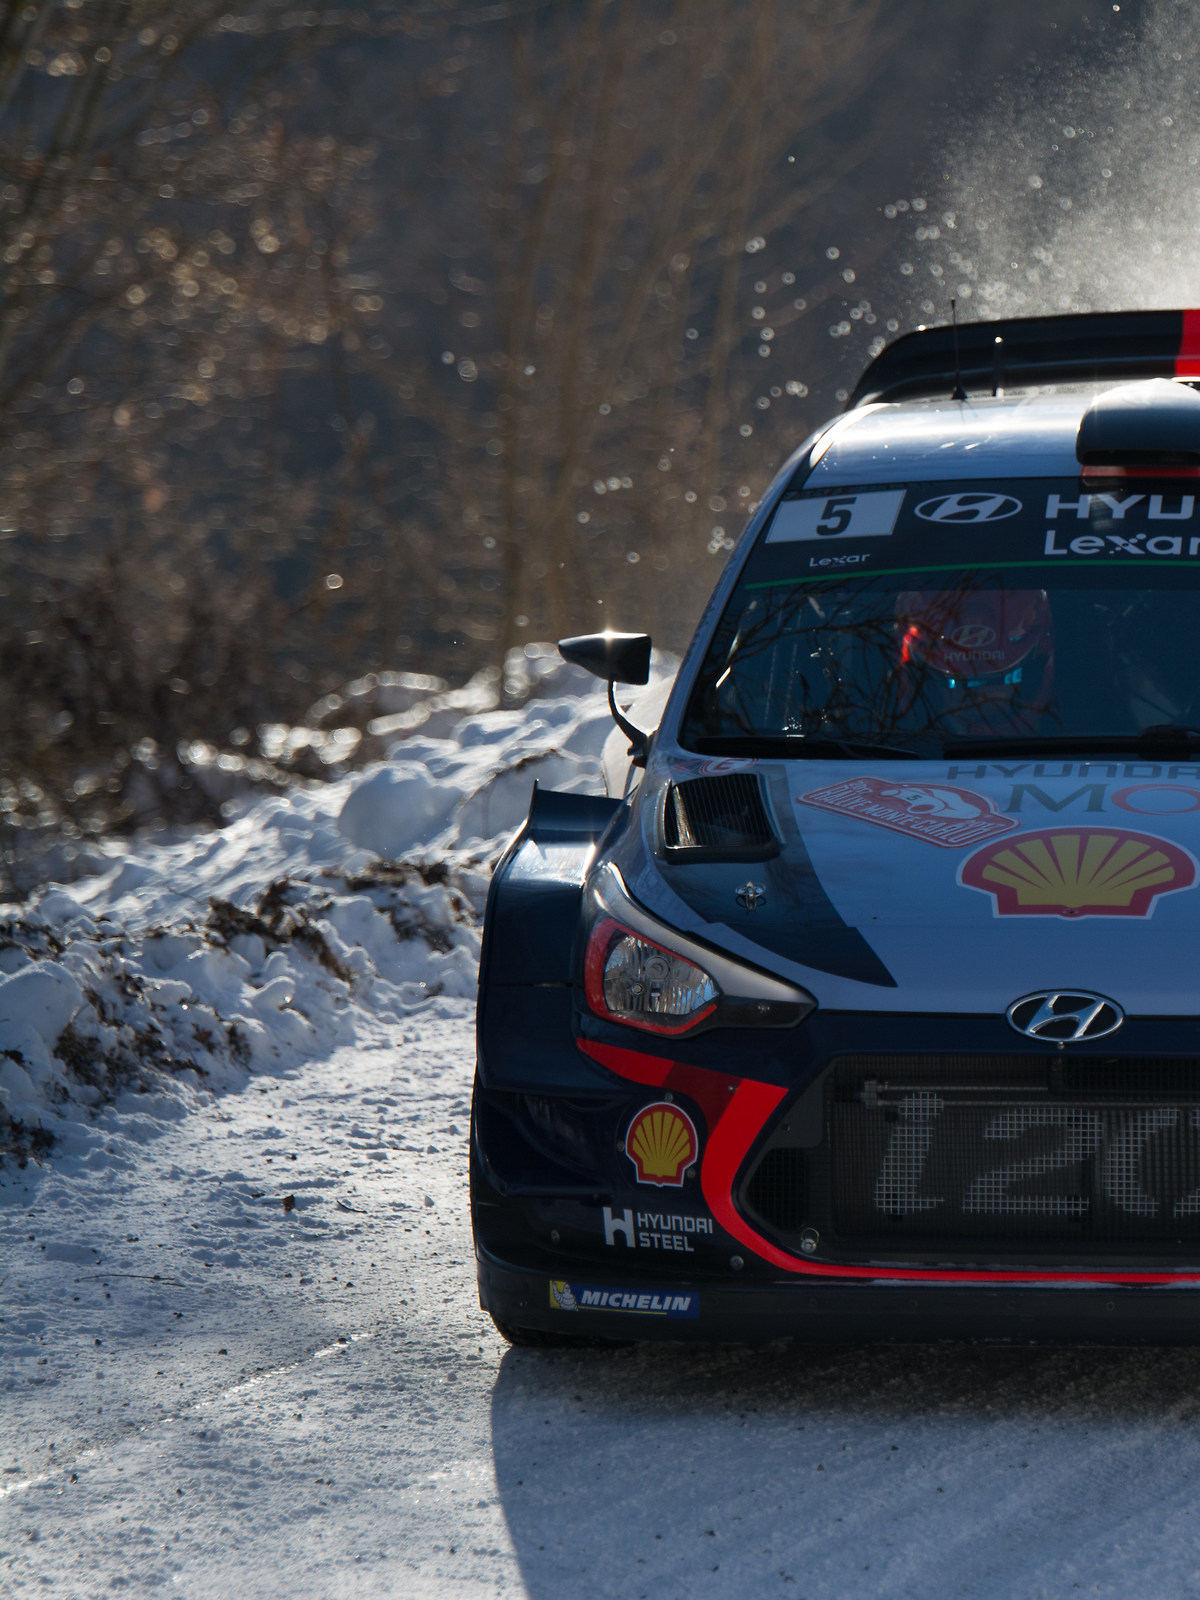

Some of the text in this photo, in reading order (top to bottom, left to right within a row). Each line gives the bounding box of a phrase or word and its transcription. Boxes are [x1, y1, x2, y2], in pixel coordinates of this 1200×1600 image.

[815, 497, 857, 537] 5
[808, 554, 871, 568] Lexar
[943, 650, 1005, 663] HYUNDAI
[808, 784, 992, 843] RALLYE MONTE-CARLO
[637, 1212, 713, 1234] HYUNDAI
[639, 1232, 695, 1252] STEEL
[581, 1290, 691, 1312] MICHELIN
